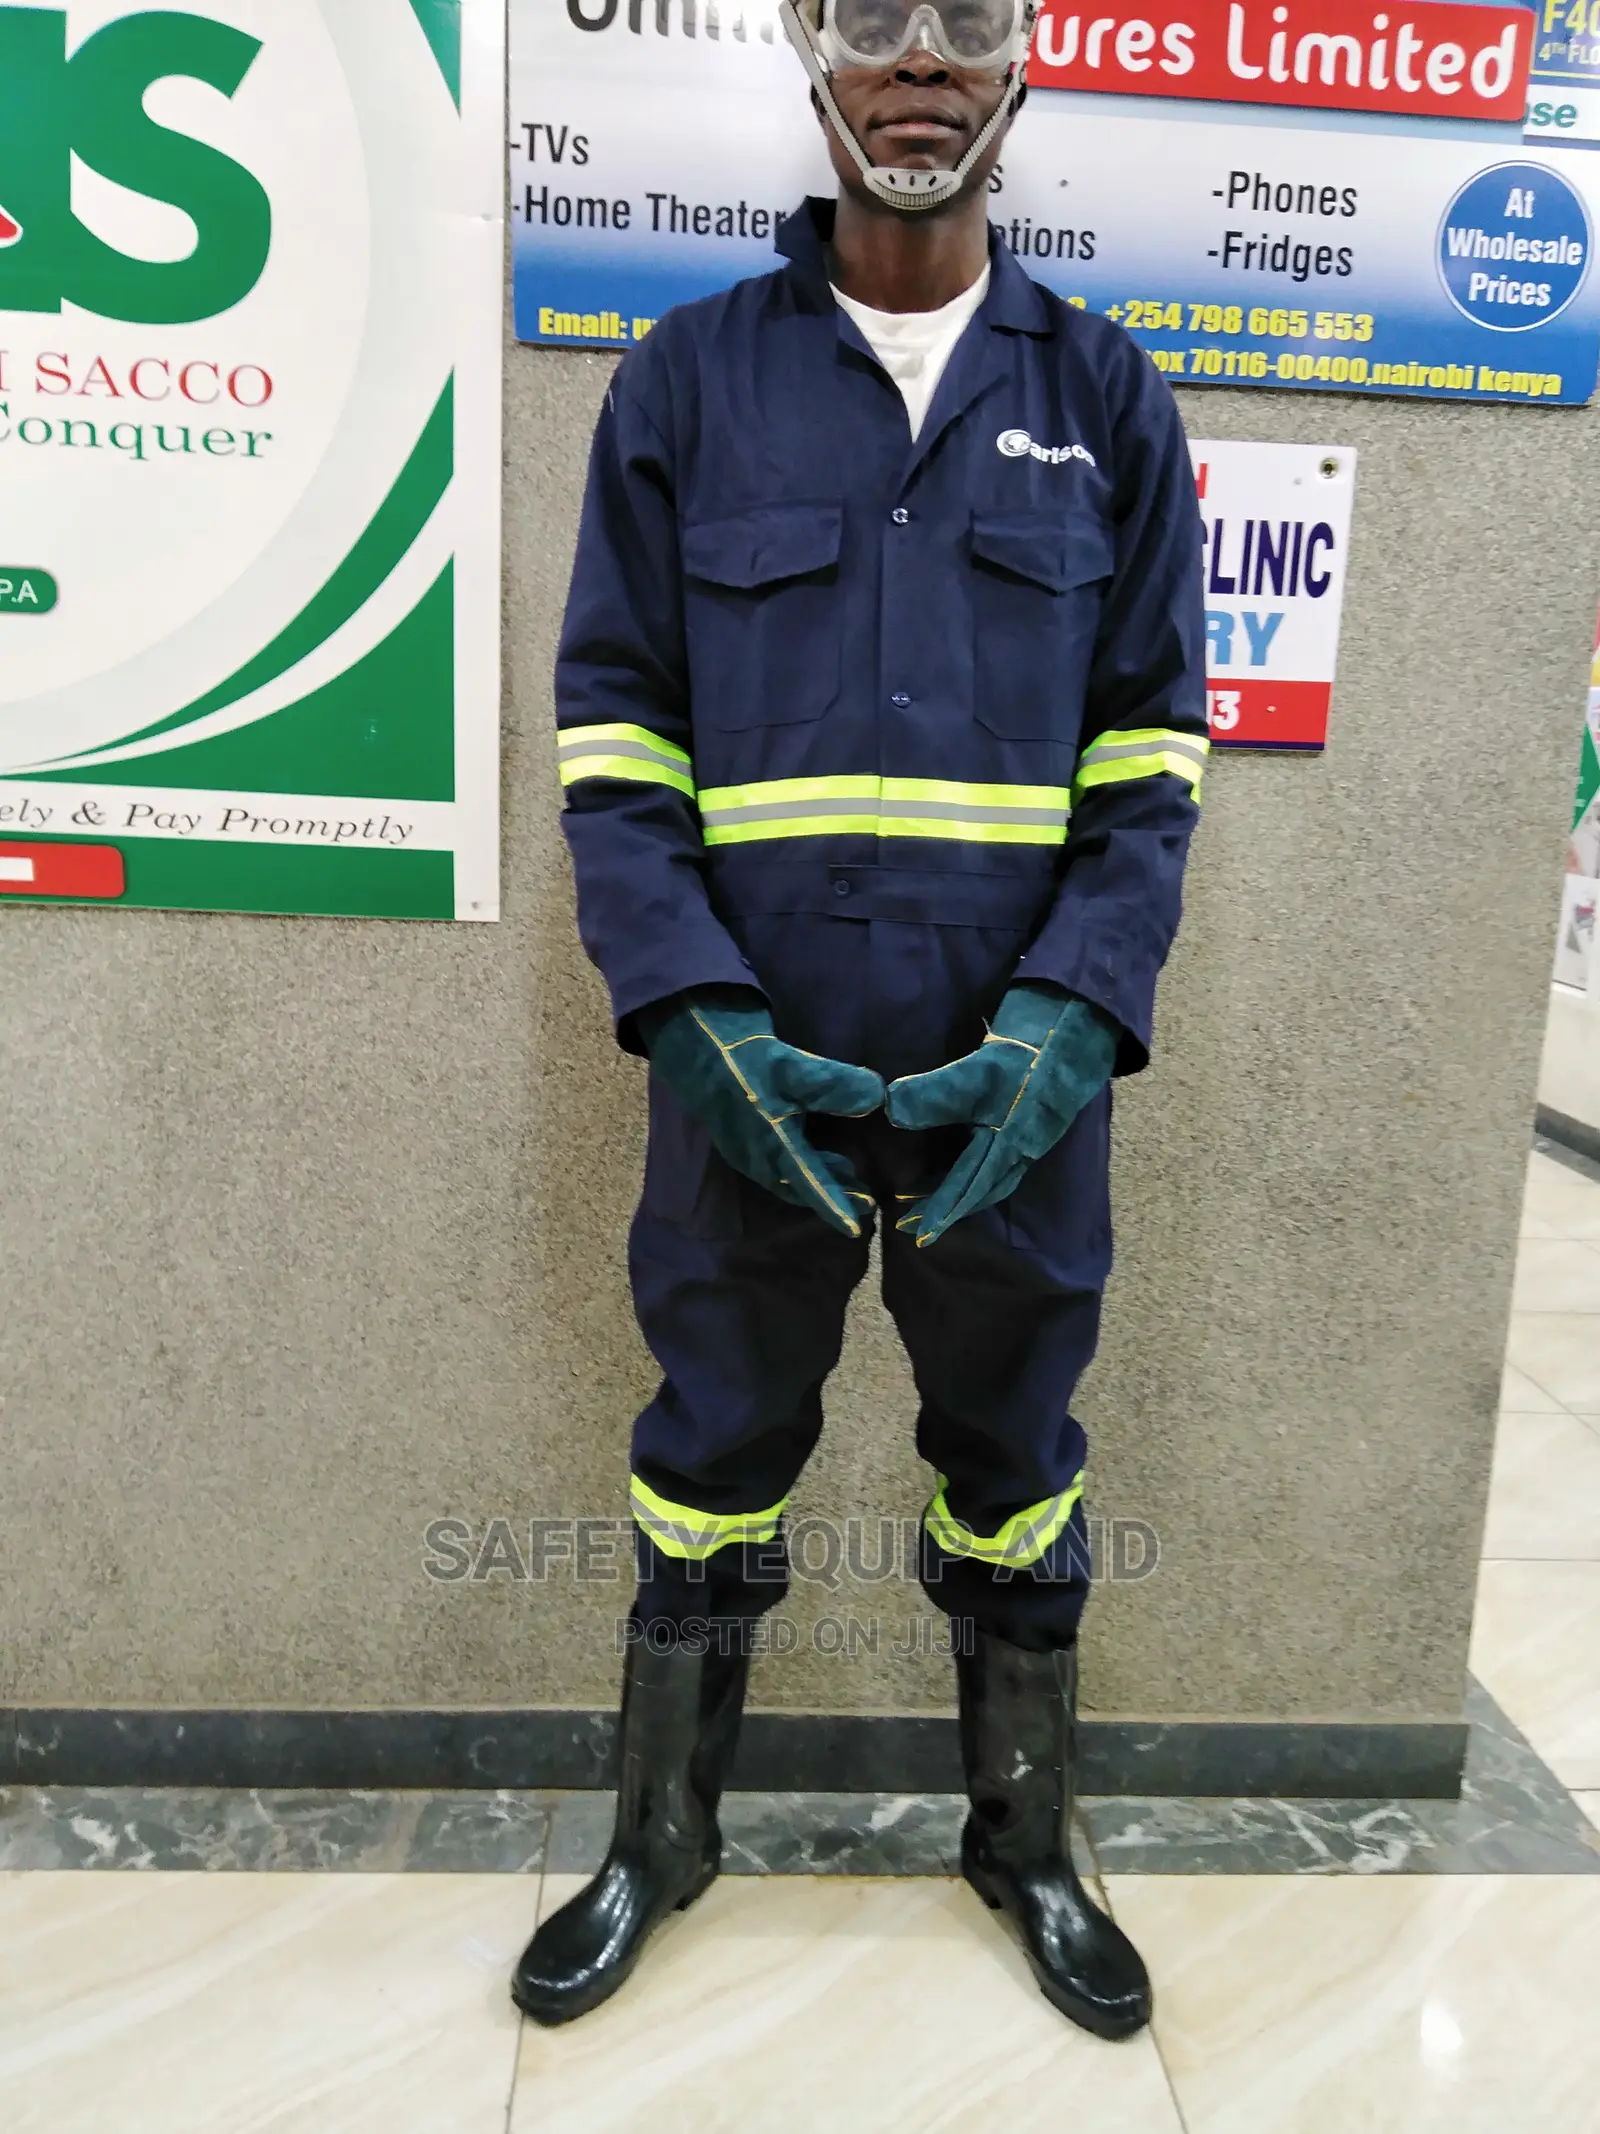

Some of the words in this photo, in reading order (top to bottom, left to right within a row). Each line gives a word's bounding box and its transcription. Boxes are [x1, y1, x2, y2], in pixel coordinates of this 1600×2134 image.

[1026, 13, 1197, 76] ures
[1226, 2, 1519, 99] Limited
[0, 6, 272, 325] S
[510, 123, 590, 165] -TVs
[1212, 170, 1358, 218] -Phones
[1503, 187, 1536, 219] At
[1207, 230, 1354, 283] -Fridges
[1447, 226, 1584, 266] Wholesale
[1468, 271, 1552, 307] Prices
[539, 307, 628, 340] Email:
[1104, 299, 1184, 331] +254
[1187, 304, 1244, 335] 798
[1248, 307, 1309, 338] 665
[1313, 312, 1374, 342] 553
[34, 351, 274, 408] SACCO
[1146, 350, 1186, 374] ox
[1476, 365, 1563, 397] kenya
[1200, 518, 1334, 599] LINIC
[70, 800, 107, 827] &
[122, 802, 203, 835] Pay
[216, 807, 414, 845] Promptly
